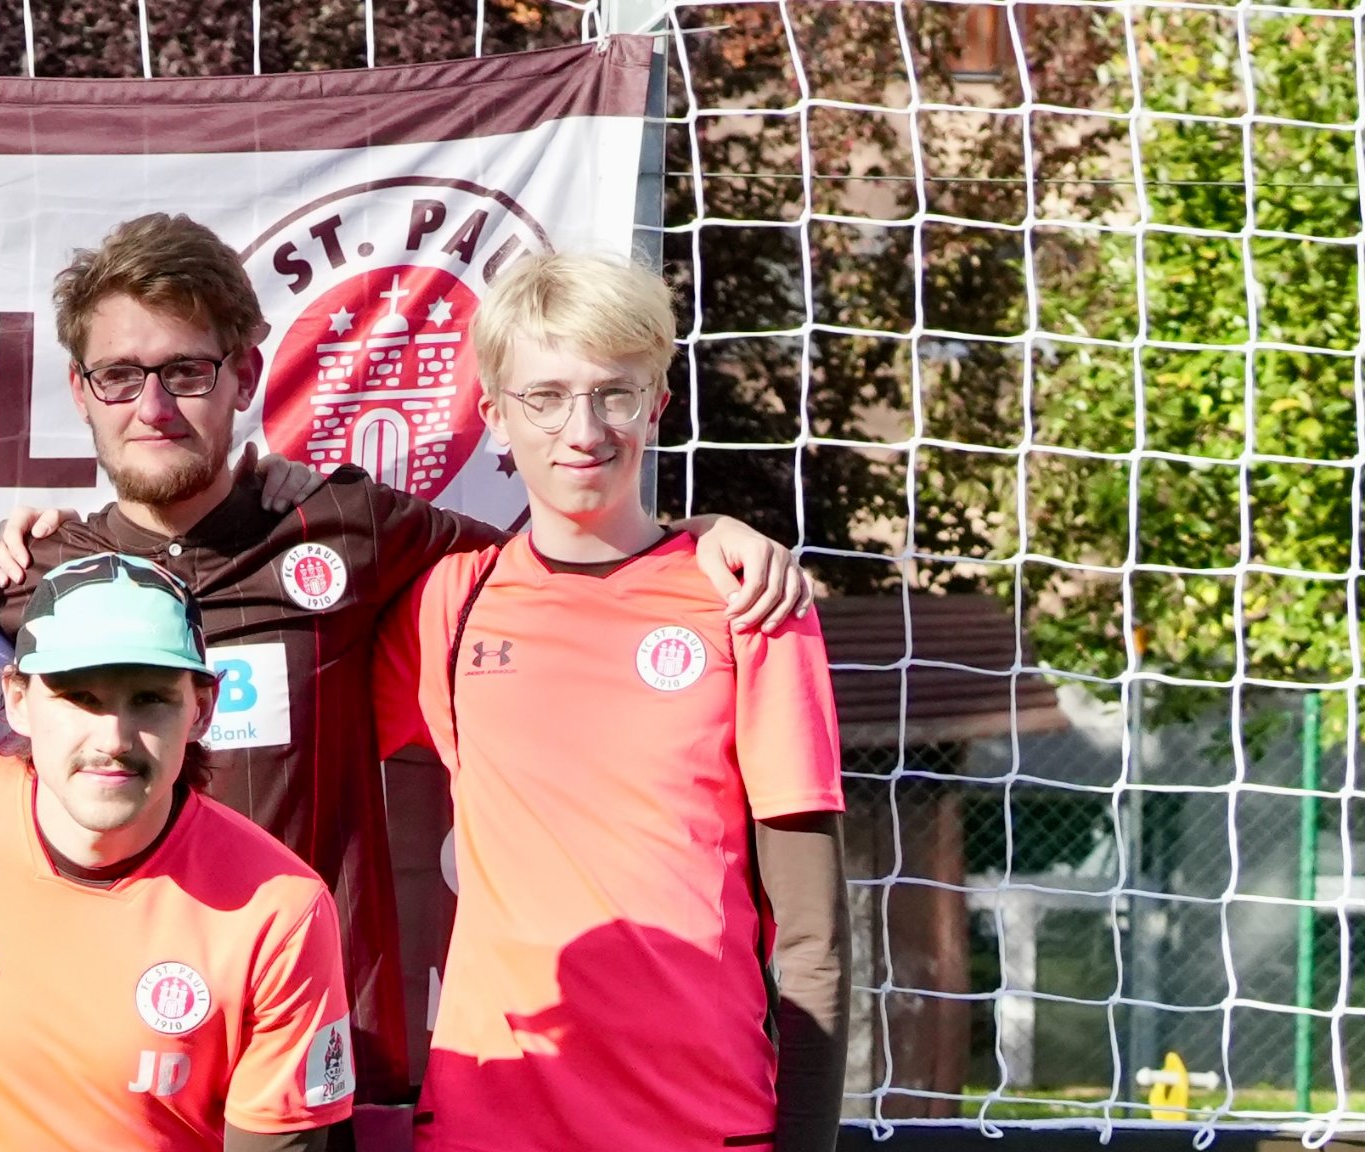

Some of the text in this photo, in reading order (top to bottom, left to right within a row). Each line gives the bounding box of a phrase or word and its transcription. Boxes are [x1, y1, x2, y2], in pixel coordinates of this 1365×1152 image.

[273, 199, 532, 296] ST. PAU
[284, 566, 293, 578] FC
[307, 545, 342, 571] PAULI
[307, 596, 331, 608] 1910
[653, 676, 681, 688] 1910
[211, 722, 258, 742] Bank
[141, 976, 154, 991] FC
[178, 965, 208, 1003] PAULI
[153, 1017, 184, 1031] 1910
[128, 1049, 192, 1097] JD
